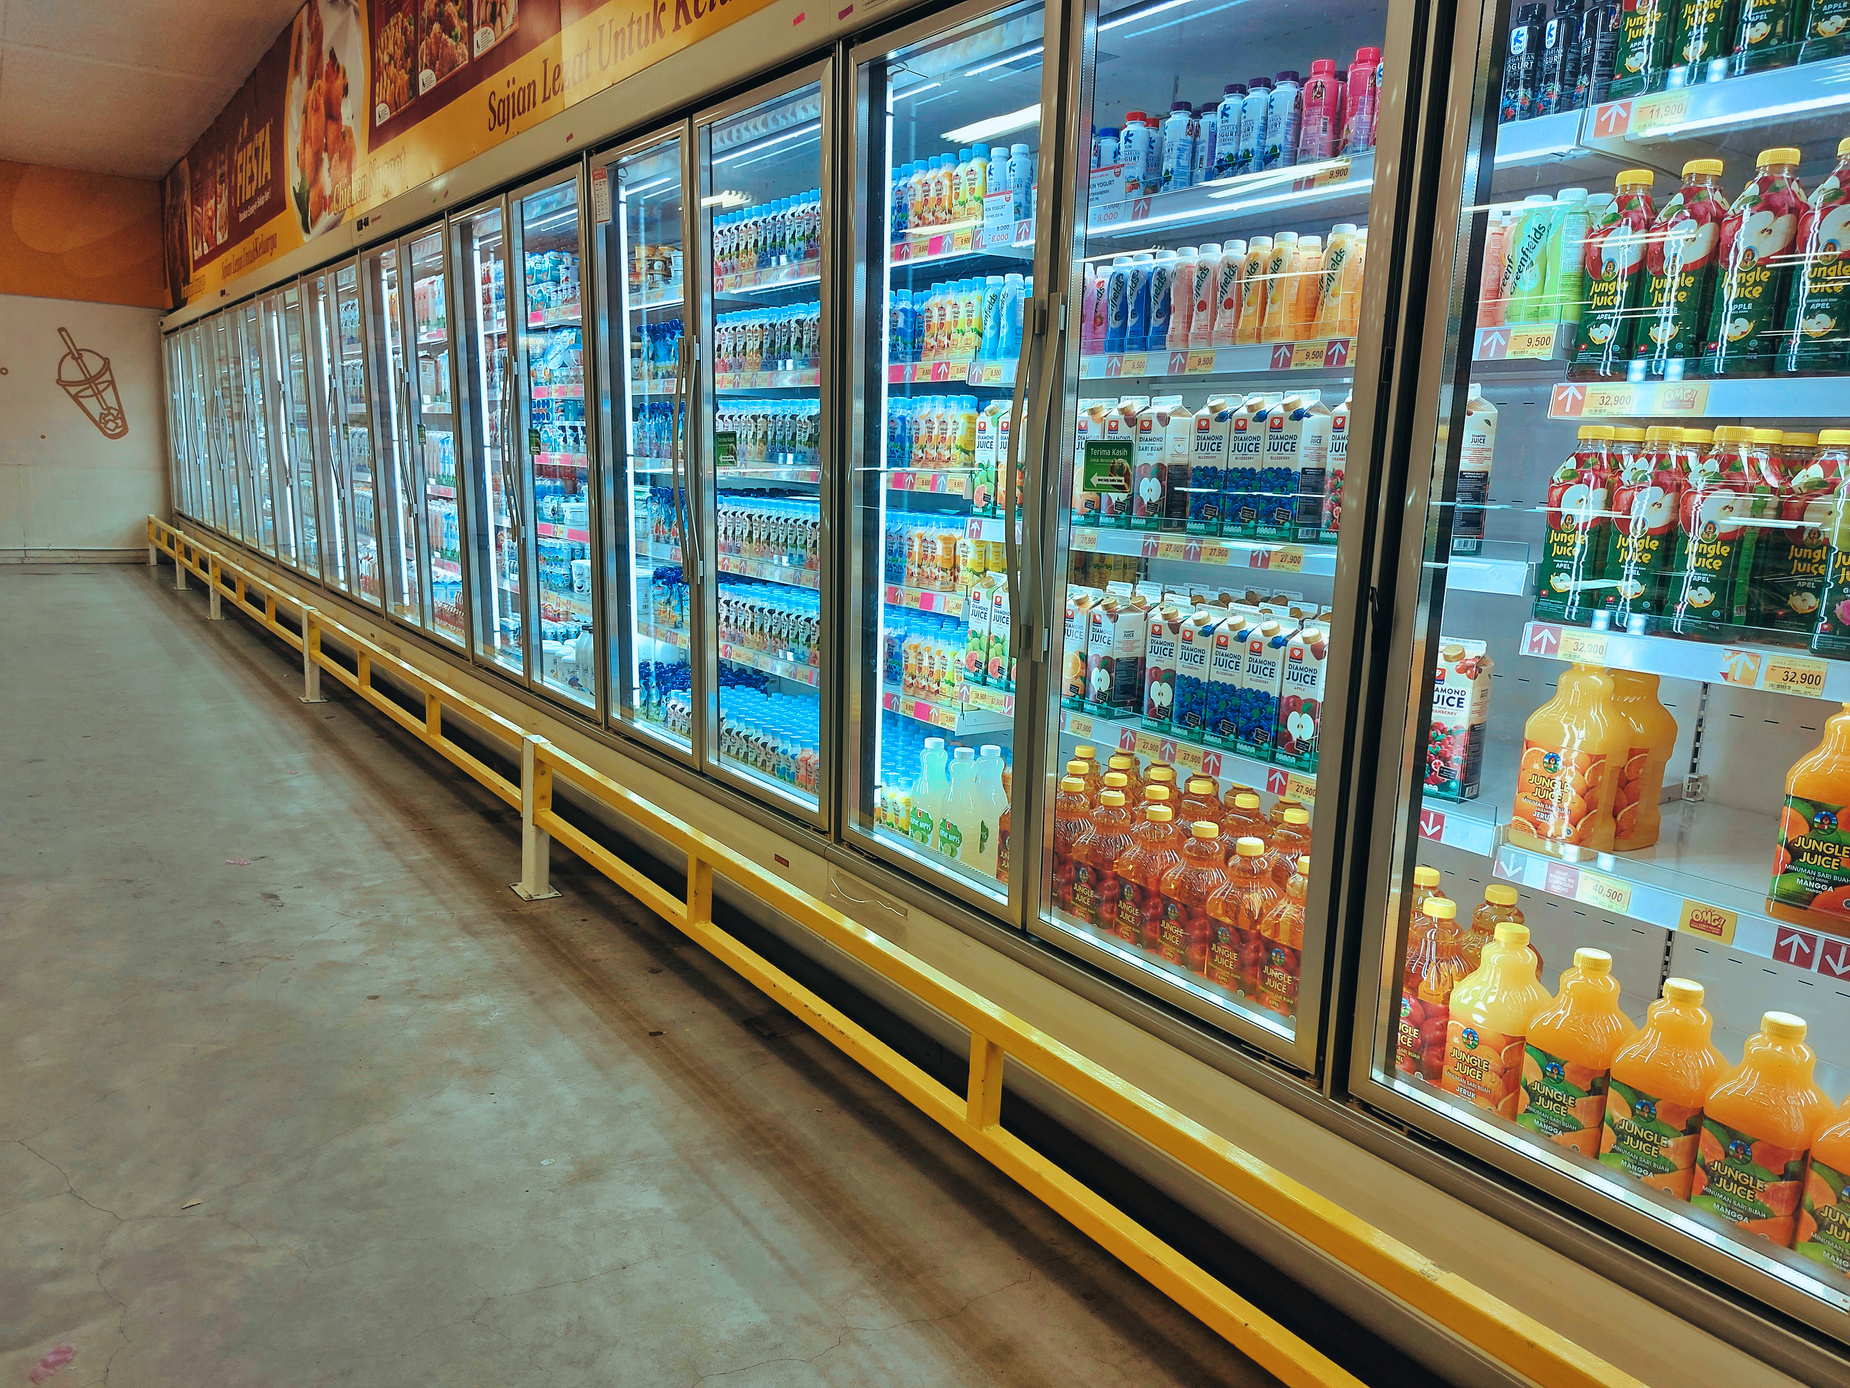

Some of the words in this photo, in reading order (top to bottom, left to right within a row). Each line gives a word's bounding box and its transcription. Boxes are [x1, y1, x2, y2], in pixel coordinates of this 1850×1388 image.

[1822, 2, 1848, 11] APPLE
[1625, 11, 1662, 31] Jungle
[488, 76, 537, 135] Sajian
[541, 39, 592, 104] Lezat
[598, 1, 666, 72] Untuk
[1649, 104, 1684, 120] 11,900
[236, 122, 272, 208] FIESTA
[1329, 167, 1349, 179] 9,900
[332, 170, 368, 215] Chicken
[368, 147, 407, 198] Nugget
[1097, 180, 1115, 188] YOGURT
[1097, 212, 1118, 222] 8.000
[1510, 223, 1546, 295] Greenfields
[1526, 335, 1551, 348] 9,500
[1197, 357, 1214, 366] 9,500
[1305, 350, 1324, 360] 9,500
[1598, 395, 1632, 407] 32,900
[977, 440, 994, 449] JUICE
[1195, 442, 1222, 452] JUICE
[1231, 442, 1260, 453] JUICE
[1266, 441, 1297, 452] JUICE
[1090, 448, 1110, 456] Terima
[1112, 448, 1128, 456] Kasih
[1208, 547, 1229, 558] 27,900
[1280, 554, 1302, 565] 27,900
[1796, 581, 1817, 589] APEL
[972, 603, 989, 612] DIAMOND
[971, 610, 988, 620] JUICE
[993, 615, 1010, 625] JUICE
[1092, 627, 1112, 636] DIAMOND
[1090, 633, 1111, 645] JUICE
[1151, 639, 1174, 647] DIAMOND
[1149, 645, 1174, 658] JUICE
[1181, 645, 1206, 654] DIAMOND
[1573, 641, 1605, 655] 32,900
[1179, 651, 1205, 665] JUICE
[1215, 651, 1242, 660] DIAMOND
[1248, 657, 1276, 667] DIAMOND
[1213, 657, 1240, 671] JUICE
[1288, 664, 1318, 674] DIAMOND
[1246, 665, 1275, 678] JUICE
[1286, 671, 1317, 686] JUICE
[1782, 671, 1822, 686] 32,900
[1142, 741, 1160, 752] 27,900
[1183, 752, 1202, 764] 27,900
[1794, 836, 1850, 858] JUNGLE
[1798, 851, 1840, 870] JUICE
[1785, 863, 1816, 876] MINUMAN
[1817, 870, 1832, 879] SARI
[1073, 882, 1094, 897] JUNGLE
[1592, 883, 1623, 902] 40,500
[1796, 878, 1835, 893] MANGGA
[1075, 894, 1090, 906] JUICE
[1118, 900, 1139, 916] JUNGLE
[1120, 912, 1135, 924] JUICE
[1691, 909, 1727, 928] OMG!
[1161, 919, 1184, 936] JUNGLE
[1162, 932, 1180, 945] JUICE
[1211, 943, 1238, 961] JUNGLE
[1214, 955, 1234, 969] JUICE
[1262, 965, 1292, 984] JUNGLE
[1265, 978, 1287, 993] JUICE
[1450, 1047, 1490, 1072] JUNGLE
[1454, 1061, 1483, 1082] JUICE
[1455, 1086, 1477, 1099] JERUK
[1531, 1080, 1576, 1107] JUNGLE
[1535, 1095, 1568, 1117] JUICE
[1533, 1119, 1564, 1137] MANGGA
[1619, 1118, 1669, 1148] JUNGLE
[1623, 1135, 1660, 1158] JUICE
[1621, 1159, 1654, 1178] MANGGA
[1652, 1162, 1670, 1172] BUAH
[1710, 1159, 1766, 1193] JUNGLE
[1702, 1185, 1732, 1204] MINUMAN
[1715, 1177, 1756, 1203] JUICE
[1713, 1202, 1750, 1223] MANGGA
